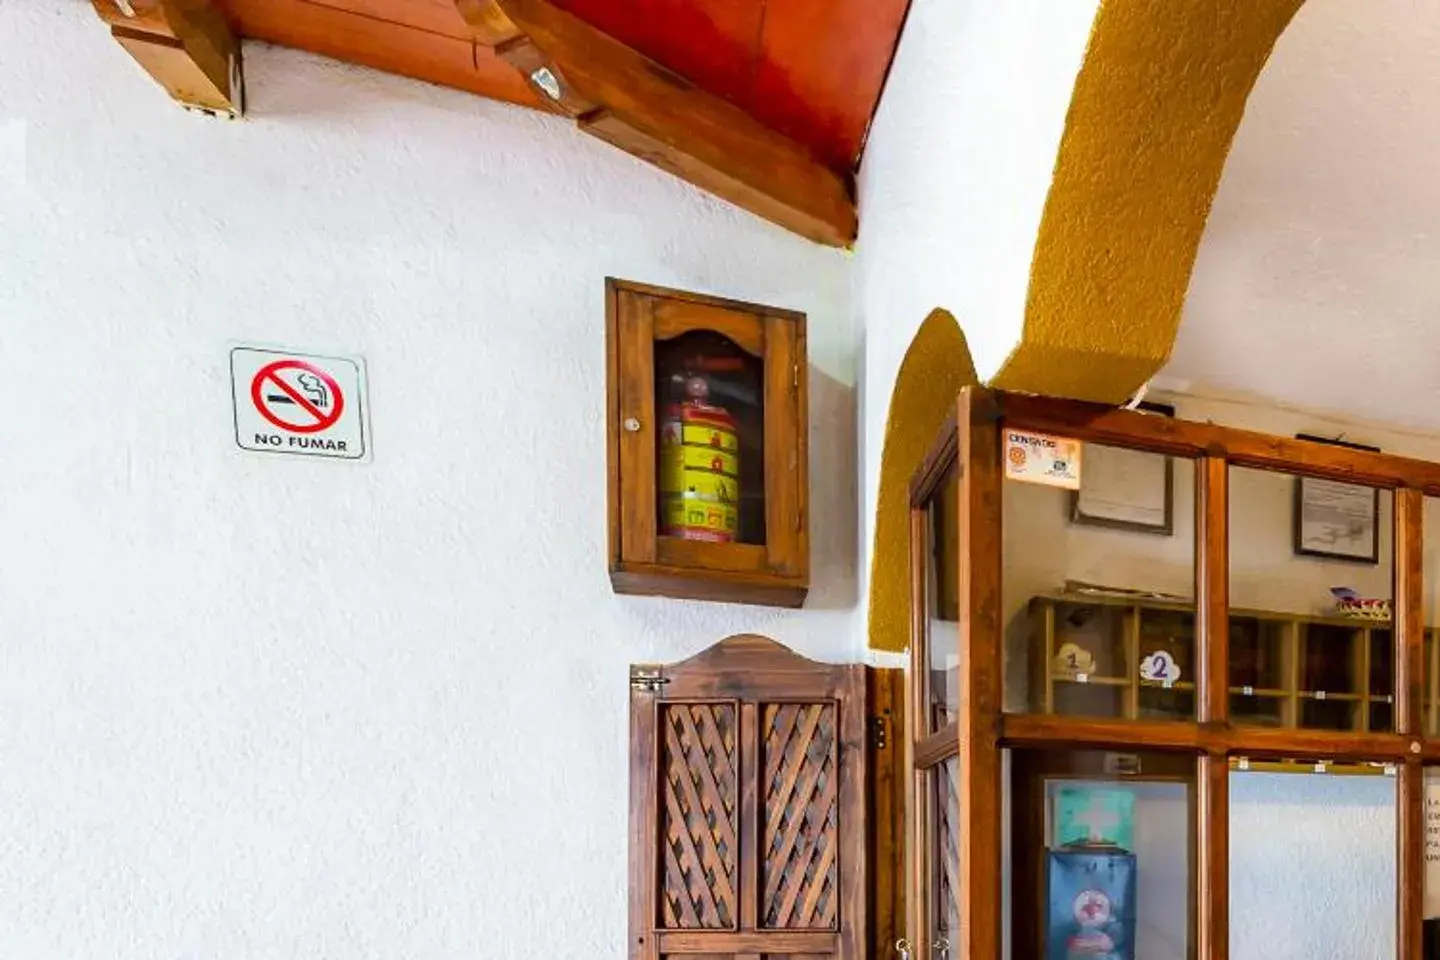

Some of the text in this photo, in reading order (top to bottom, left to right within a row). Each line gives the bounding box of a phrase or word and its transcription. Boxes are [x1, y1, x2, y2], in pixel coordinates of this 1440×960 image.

[255, 433, 347, 451] NO FUMAR
[1152, 656, 1168, 679] 2
